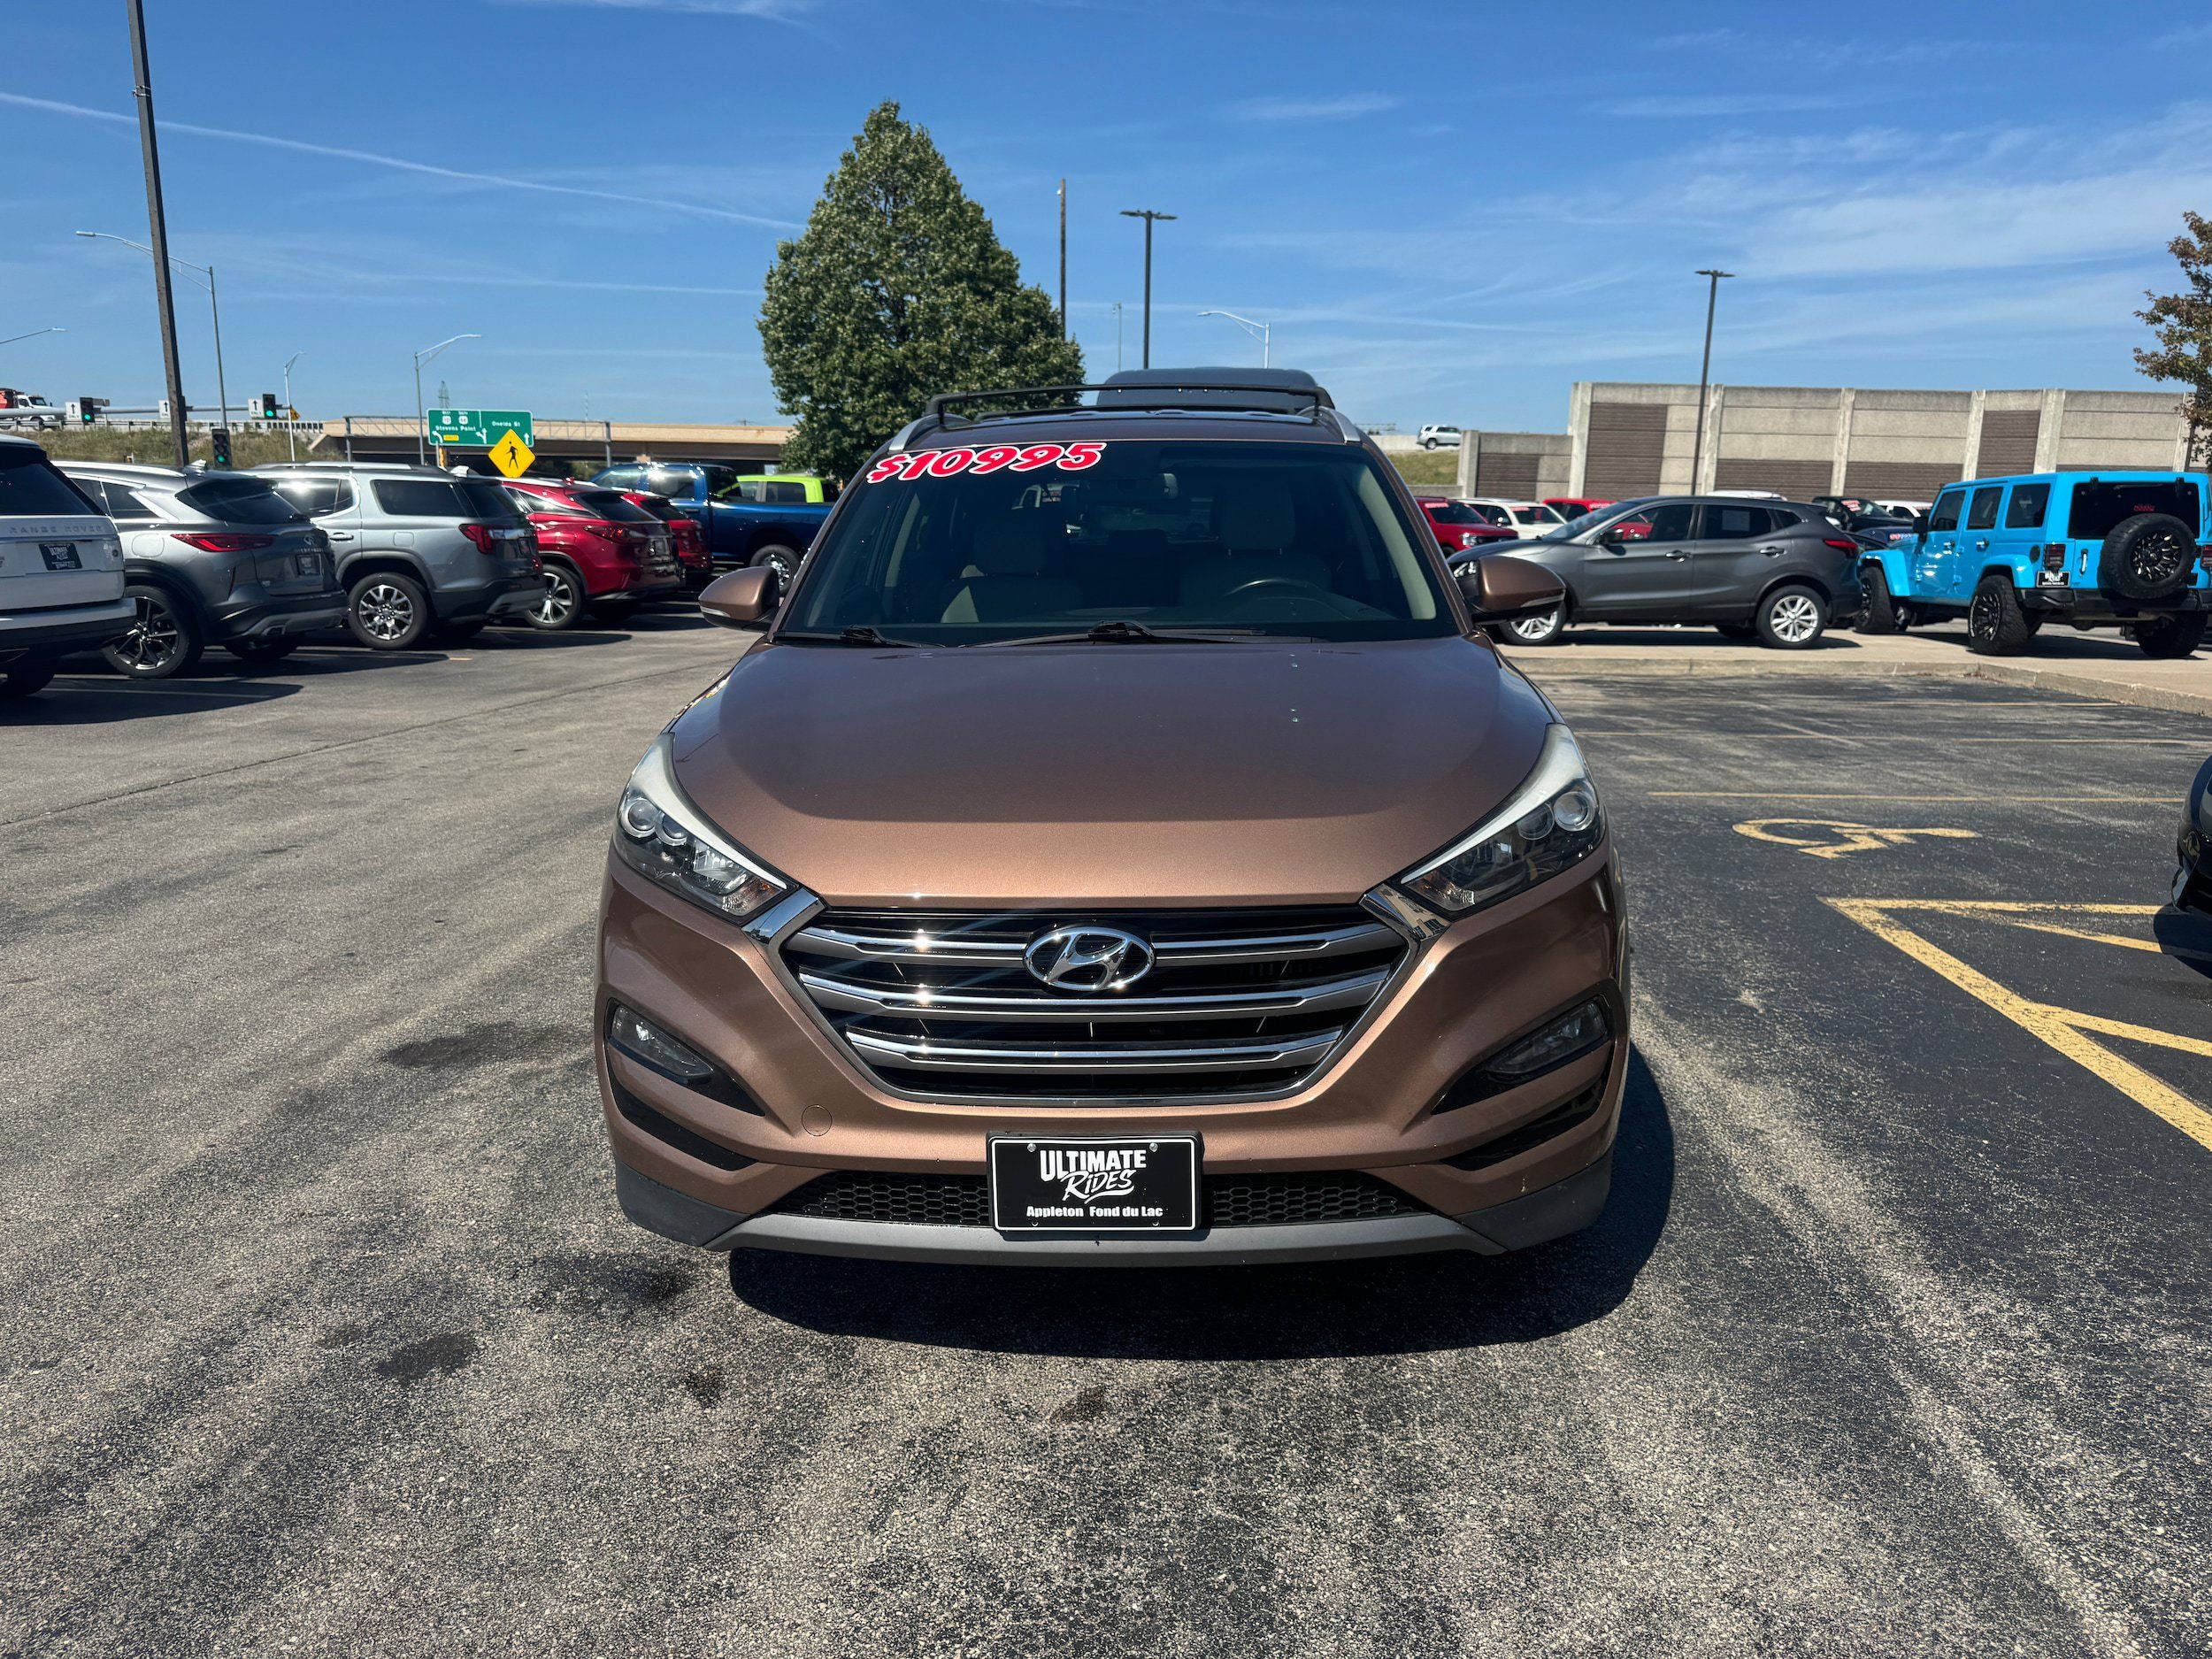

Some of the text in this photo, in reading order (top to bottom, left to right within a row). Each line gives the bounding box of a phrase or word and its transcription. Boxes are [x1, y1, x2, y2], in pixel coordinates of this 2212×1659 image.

[866, 442, 1107, 483] $10995
[10, 526, 58, 534] RANGE
[1040, 1149, 1147, 1182] ULTIMATE
[1026, 1206, 1164, 1218] Appleton Fond du Lac
